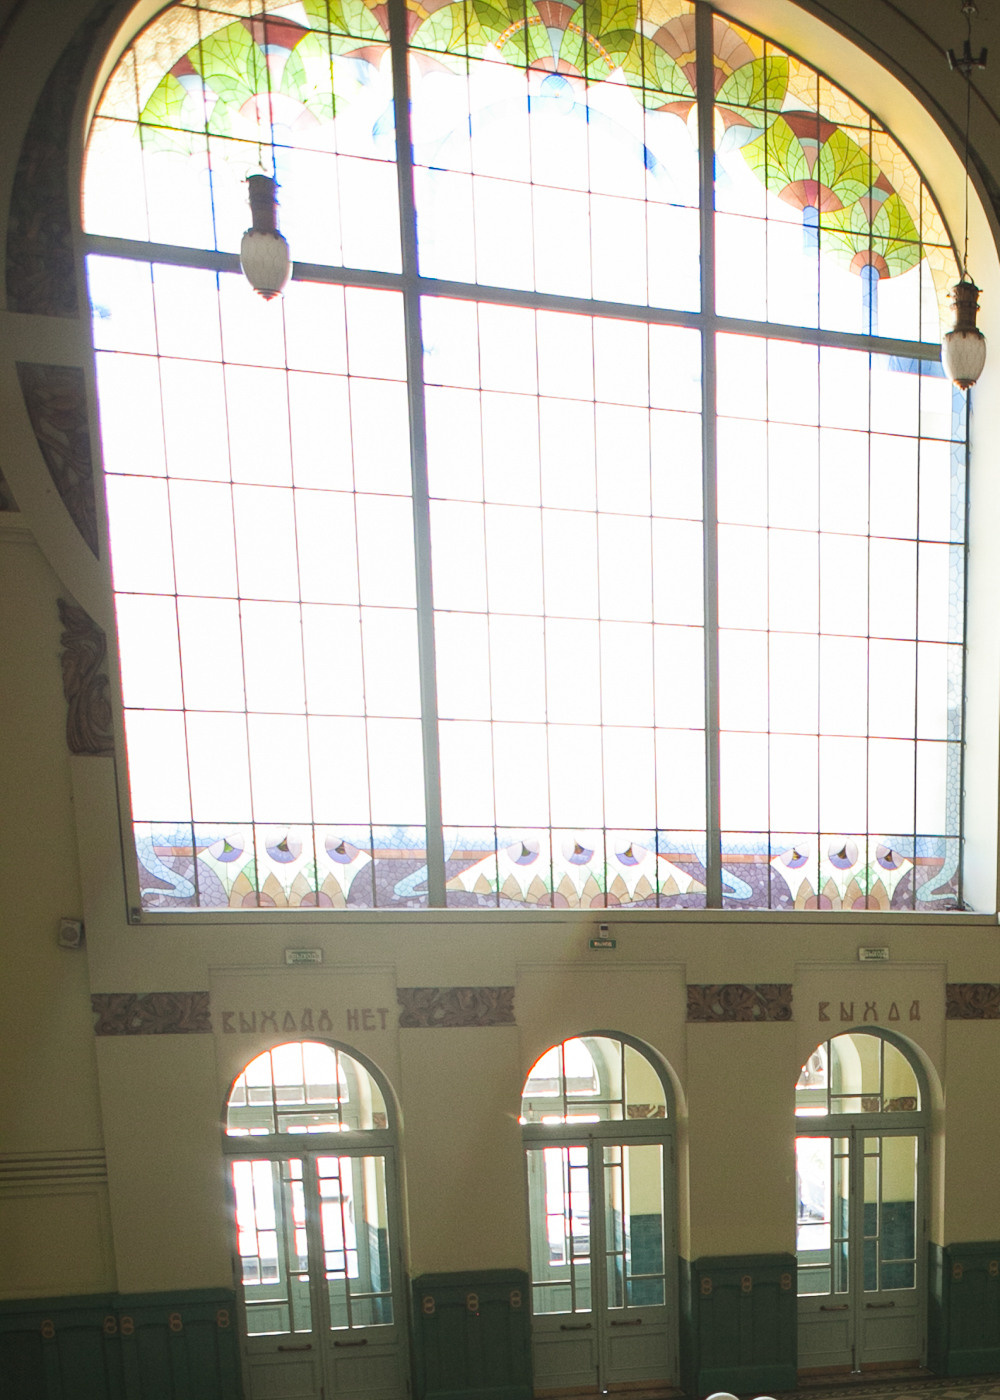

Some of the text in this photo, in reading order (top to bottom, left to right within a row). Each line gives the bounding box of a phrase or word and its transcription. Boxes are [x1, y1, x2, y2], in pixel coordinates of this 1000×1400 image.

[221, 1007, 389, 1034] ВЫХОДА НЕТ
[818, 1000, 921, 1022] ВЫХОД
